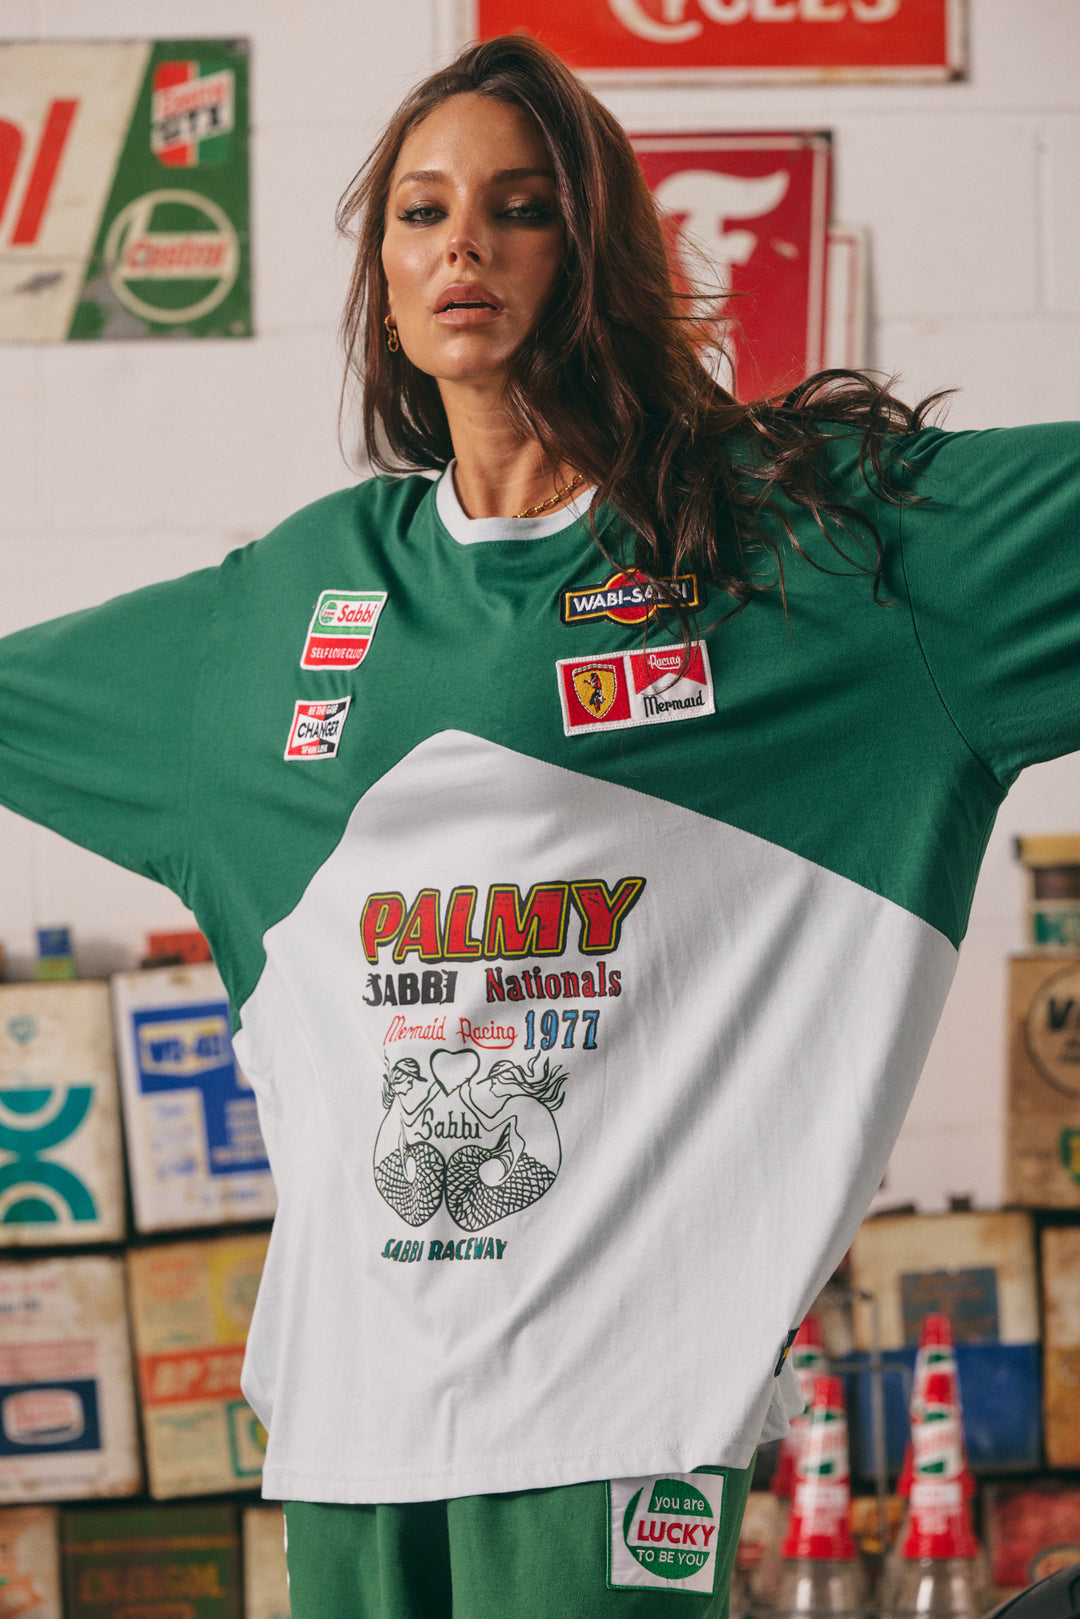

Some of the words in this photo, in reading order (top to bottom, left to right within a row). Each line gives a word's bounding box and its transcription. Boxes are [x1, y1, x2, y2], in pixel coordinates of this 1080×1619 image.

[337, 603, 377, 623] Sabbi
[310, 646, 330, 659] SELF
[328, 647, 347, 659] LOVE
[648, 654, 682, 670] Racing
[643, 690, 705, 717] Mermaid
[360, 876, 647, 965] PALMY
[485, 961, 621, 1003] Nationals
[382, 1015, 447, 1046] Mermaid
[456, 1017, 518, 1049] Racing
[524, 1009, 600, 1051] 1977
[414, 1107, 482, 1140] Sabbi
[381, 1239, 425, 1263] SABBI
[428, 1237, 508, 1261] RACEWAY
[654, 1496, 680, 1511] you
[683, 1499, 705, 1511] are
[637, 1520, 715, 1547] LUCKY
[636, 1549, 655, 1562] TO
[658, 1551, 675, 1563] BE
[678, 1553, 704, 1567] YOU
